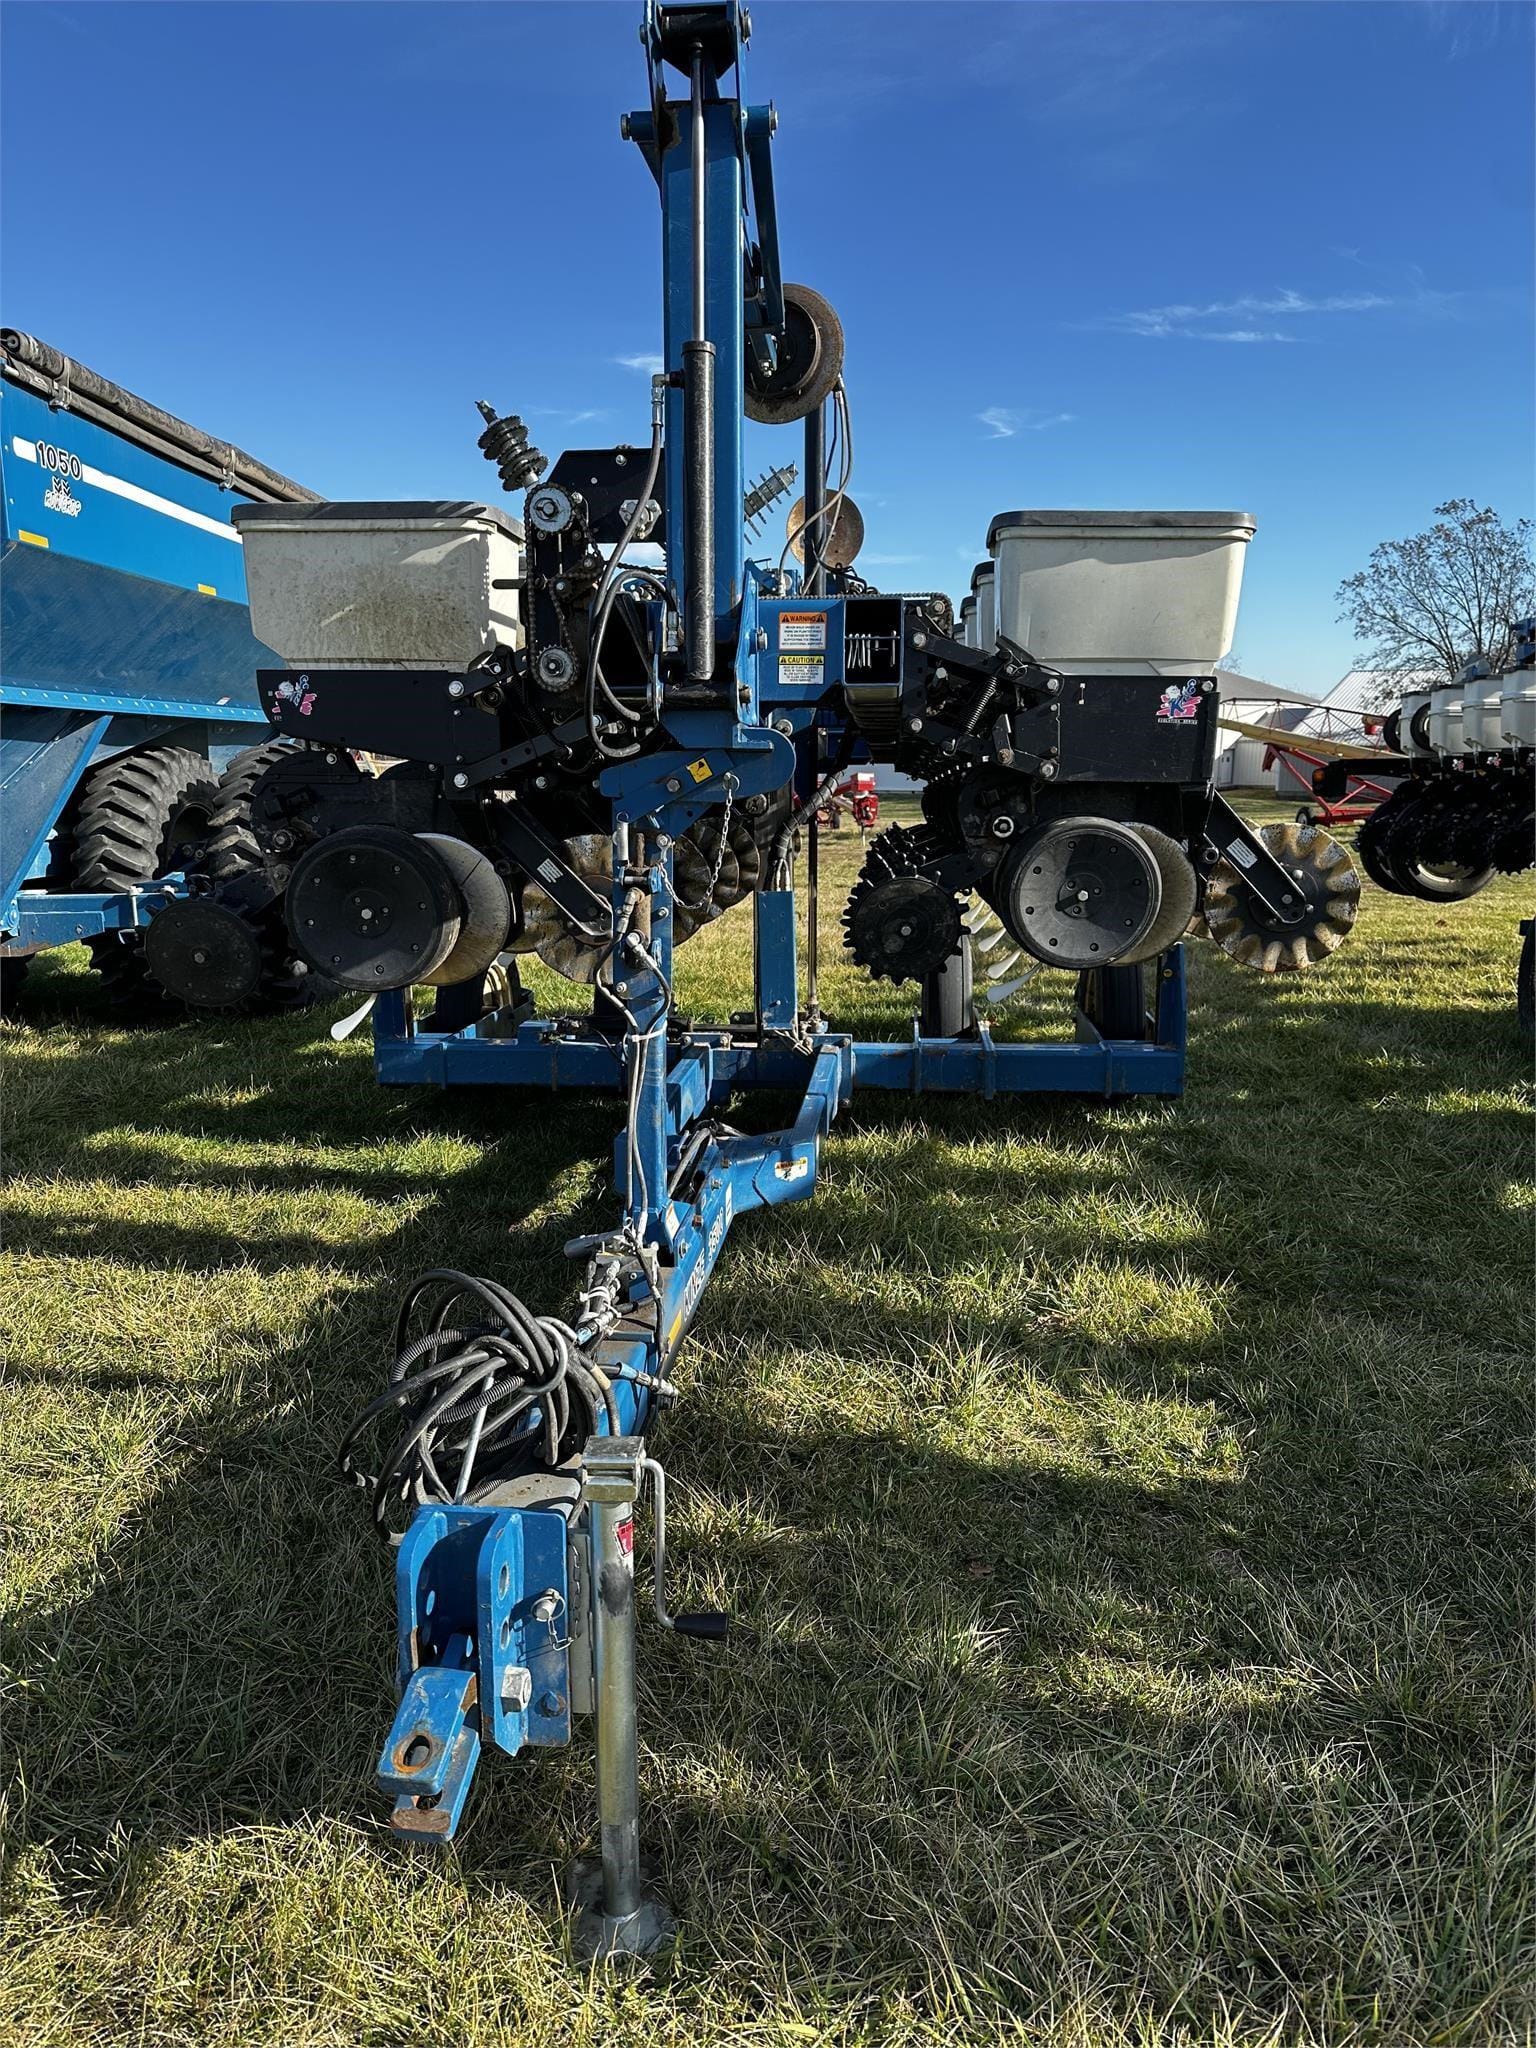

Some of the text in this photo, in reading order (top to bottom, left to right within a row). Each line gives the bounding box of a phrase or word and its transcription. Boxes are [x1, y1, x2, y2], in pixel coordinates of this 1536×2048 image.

[37, 440, 81, 480] 1050
[789, 615, 817, 623] WARNING
[787, 656, 815, 664] CAUTION
